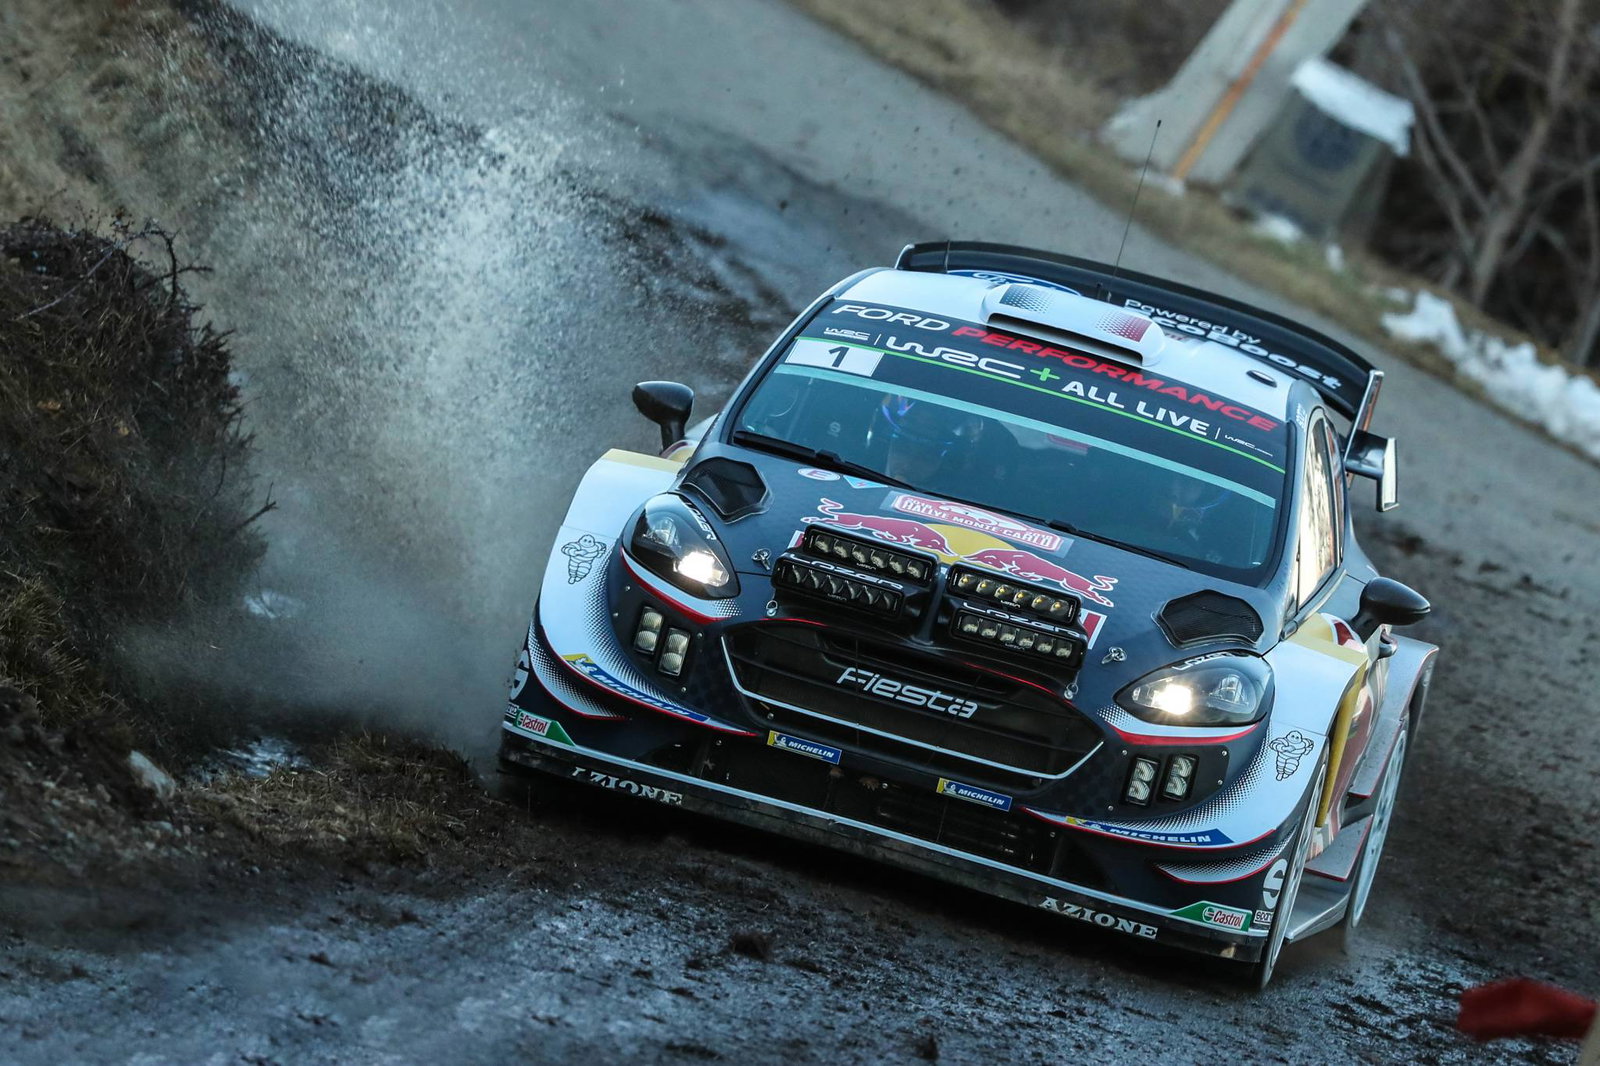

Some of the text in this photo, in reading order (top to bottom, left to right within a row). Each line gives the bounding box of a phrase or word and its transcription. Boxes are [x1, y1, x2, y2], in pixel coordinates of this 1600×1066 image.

[1124, 299, 1261, 345] Powered by
[828, 346, 850, 368] 1
[832, 304, 951, 331] FORD
[952, 326, 1279, 432] PERFORMANCE
[1150, 316, 1343, 390] coBoost
[1062, 380, 1125, 409] ALL
[1136, 400, 1210, 436] LIVE
[902, 500, 949, 519] RALLYE
[593, 673, 690, 716] MICHELIN
[836, 667, 978, 718] Fiesta
[522, 715, 548, 733] Castrol
[788, 741, 834, 758] MICHELIN
[958, 789, 1004, 806] MICHELIN
[1109, 829, 1211, 843] MICHELIN
[1039, 896, 1159, 940] AZIONE
[1213, 910, 1244, 927] Castrol
